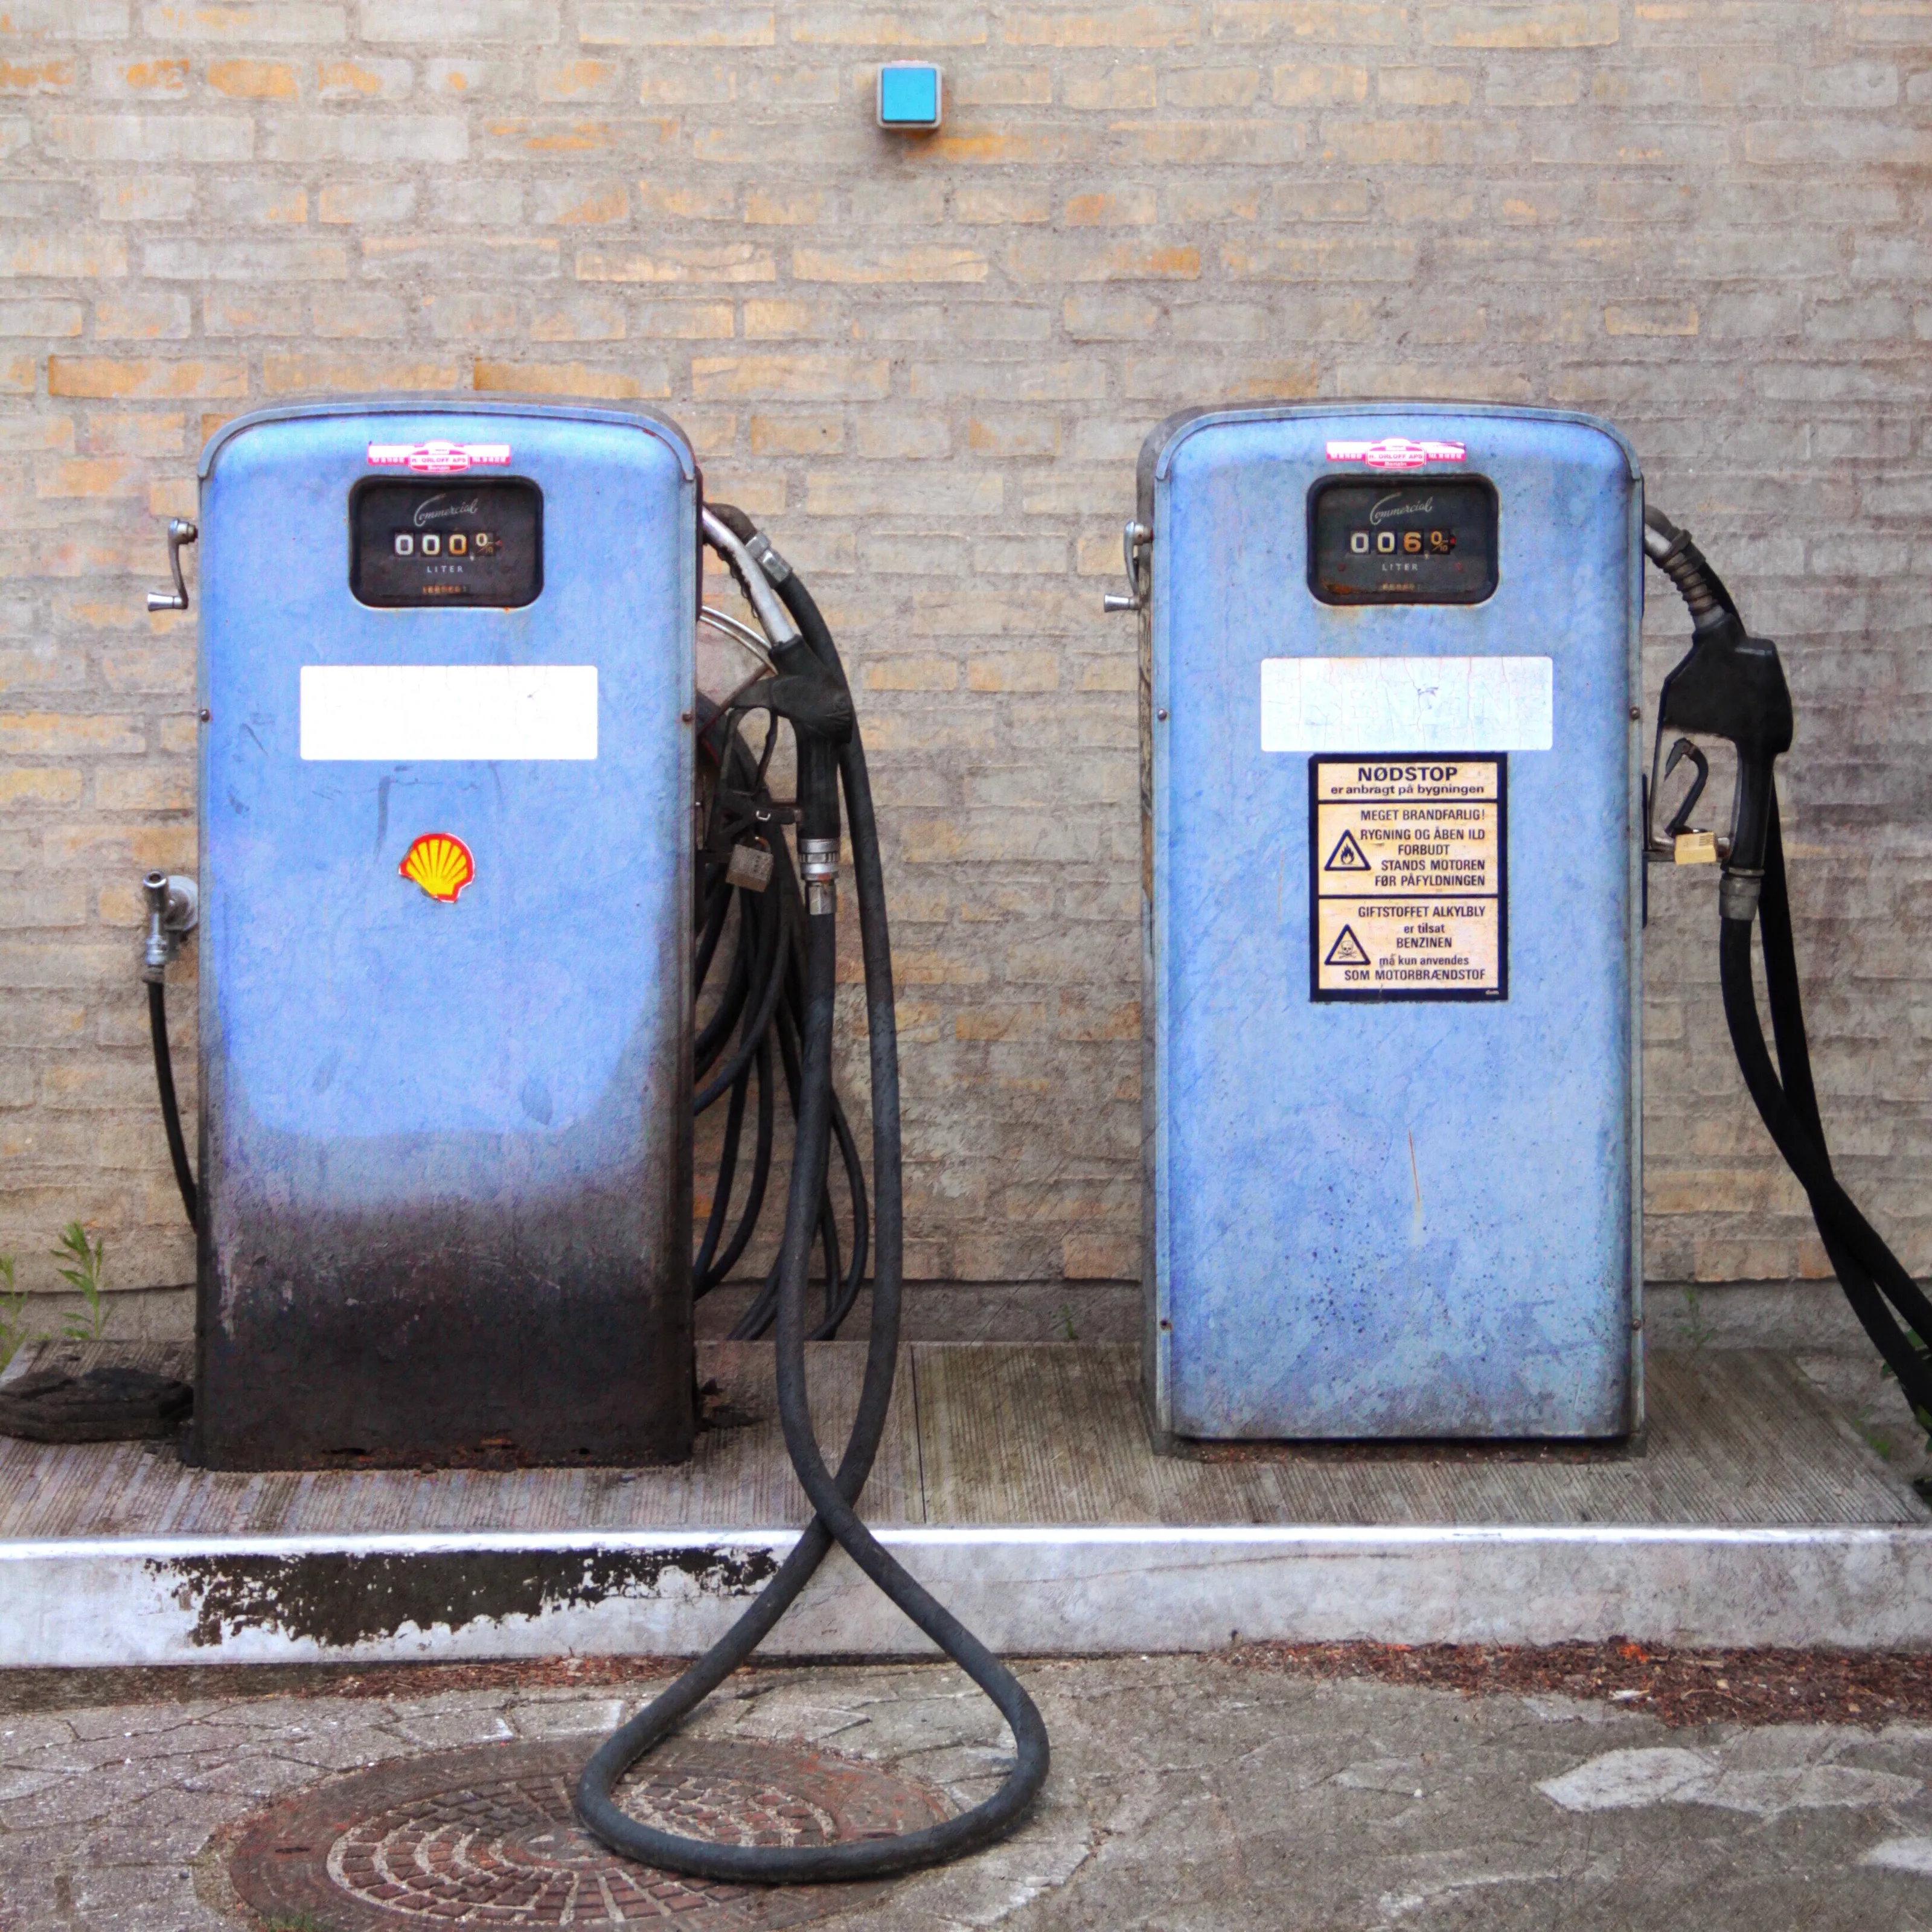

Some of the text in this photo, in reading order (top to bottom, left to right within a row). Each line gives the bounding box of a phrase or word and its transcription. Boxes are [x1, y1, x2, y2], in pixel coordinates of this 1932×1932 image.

[414, 493, 478, 526] Commercial
[1369, 491, 1433, 525] Commercial
[1358, 766, 1457, 781] NØDSTOP
[1346, 784, 1395, 796] anbragt
[1398, 784, 1413, 796] på
[1418, 784, 1485, 795] bygningen
[1360, 809, 1485, 820] MEGET BRANDFARLIG!
[1360, 827, 1485, 840] RYGNING OG ÅBEN ILD
[1398, 844, 1450, 855] FORBUDT
[1381, 859, 1485, 871] STANDS MOTOREN
[1375, 873, 1485, 886] FØR PÅFYLDNINGEN
[1358, 906, 1485, 917] GIFTSTOFFET ALKYLBLY
[1404, 923, 1445, 933] er tilsat
[1396, 938, 1452, 948] BENZINEN
[1379, 955, 1469, 965] må kun anvendes
[1344, 969, 1485, 980] SOM MOTORBRÆNDSTOF
